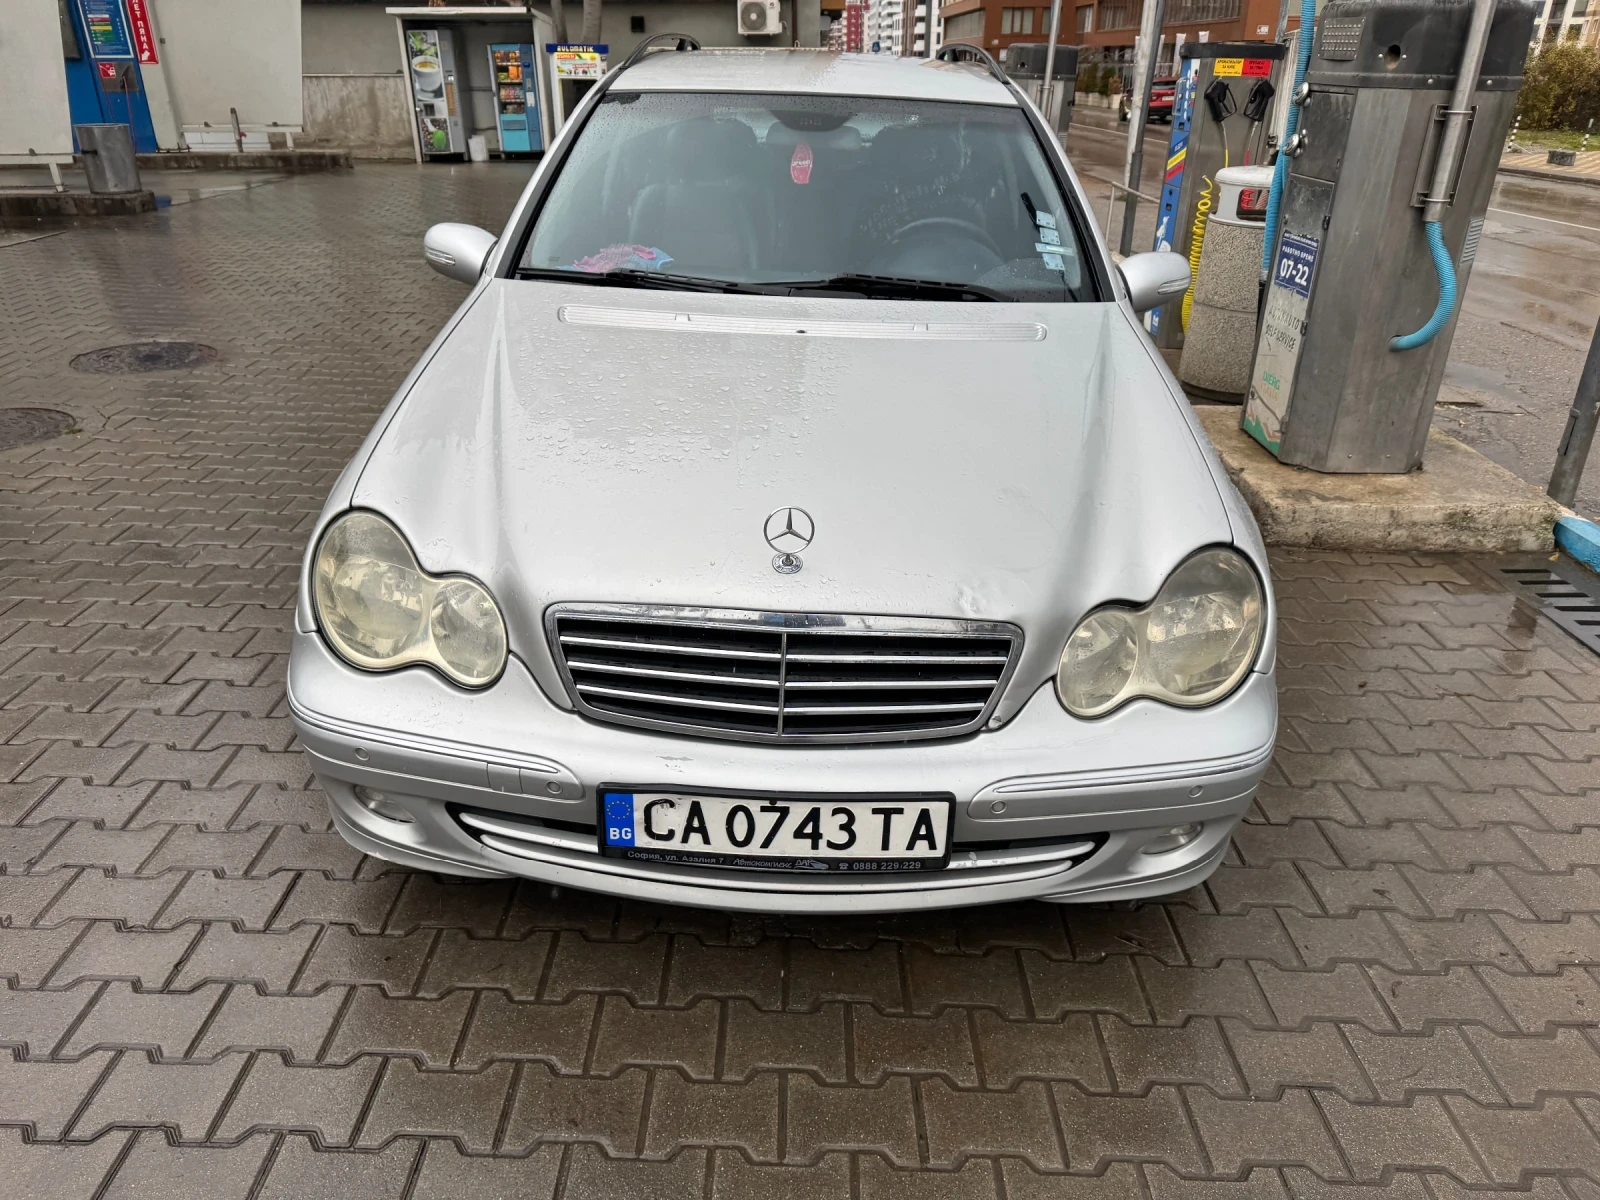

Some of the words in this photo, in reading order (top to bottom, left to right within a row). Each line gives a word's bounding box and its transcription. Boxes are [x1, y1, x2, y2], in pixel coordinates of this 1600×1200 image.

[138, 21, 149, 49] ПЯНА
[1282, 246, 1300, 257] РАБОТНО
[1301, 252, 1314, 262] ВРЕМЕ
[1280, 258, 1309, 286] 07-22
[609, 828, 632, 840] BG
[643, 798, 712, 845] CA
[725, 804, 856, 851] 0743
[871, 807, 937, 851] TA
[627, 851, 663, 861] София,
[665, 854, 679, 862] ул.
[682, 855, 716, 864] Азалия
[853, 862, 877, 870] 0888
[881, 862, 899, 870] 229
[903, 861, 921, 869] 229
